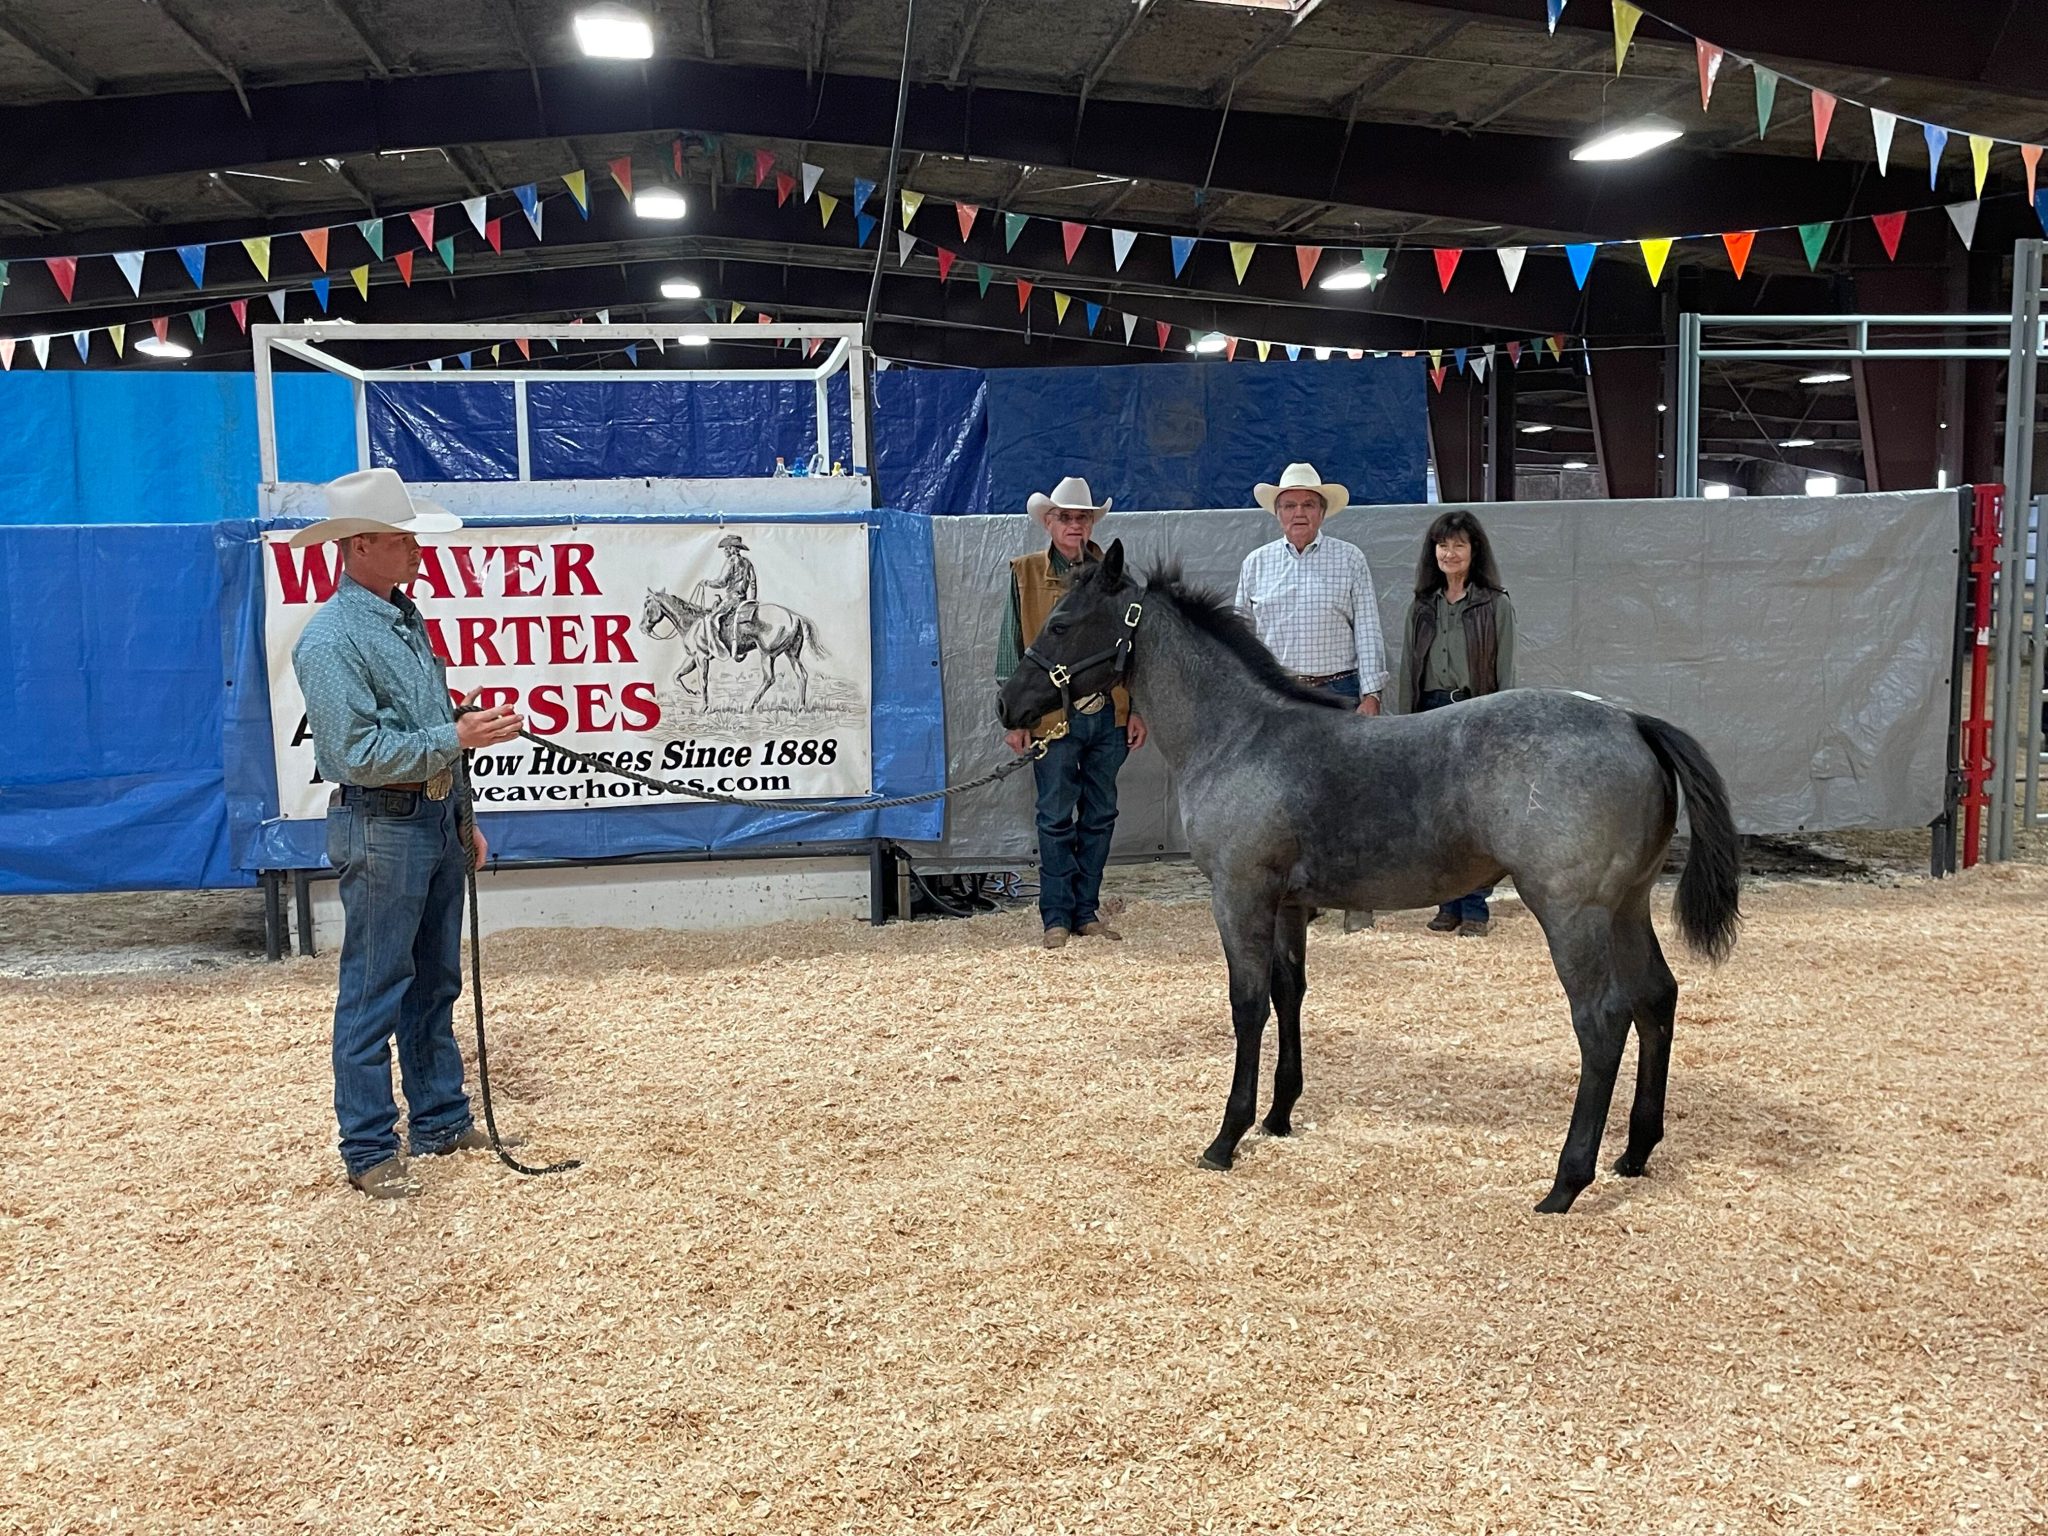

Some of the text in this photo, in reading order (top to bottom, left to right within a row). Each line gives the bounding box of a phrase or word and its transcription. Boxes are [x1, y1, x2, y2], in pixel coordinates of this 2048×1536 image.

[269, 542, 603, 604] WAVER
[425, 614, 639, 667] ARTER
[468, 738, 838, 777] ow Horses Since 1888
